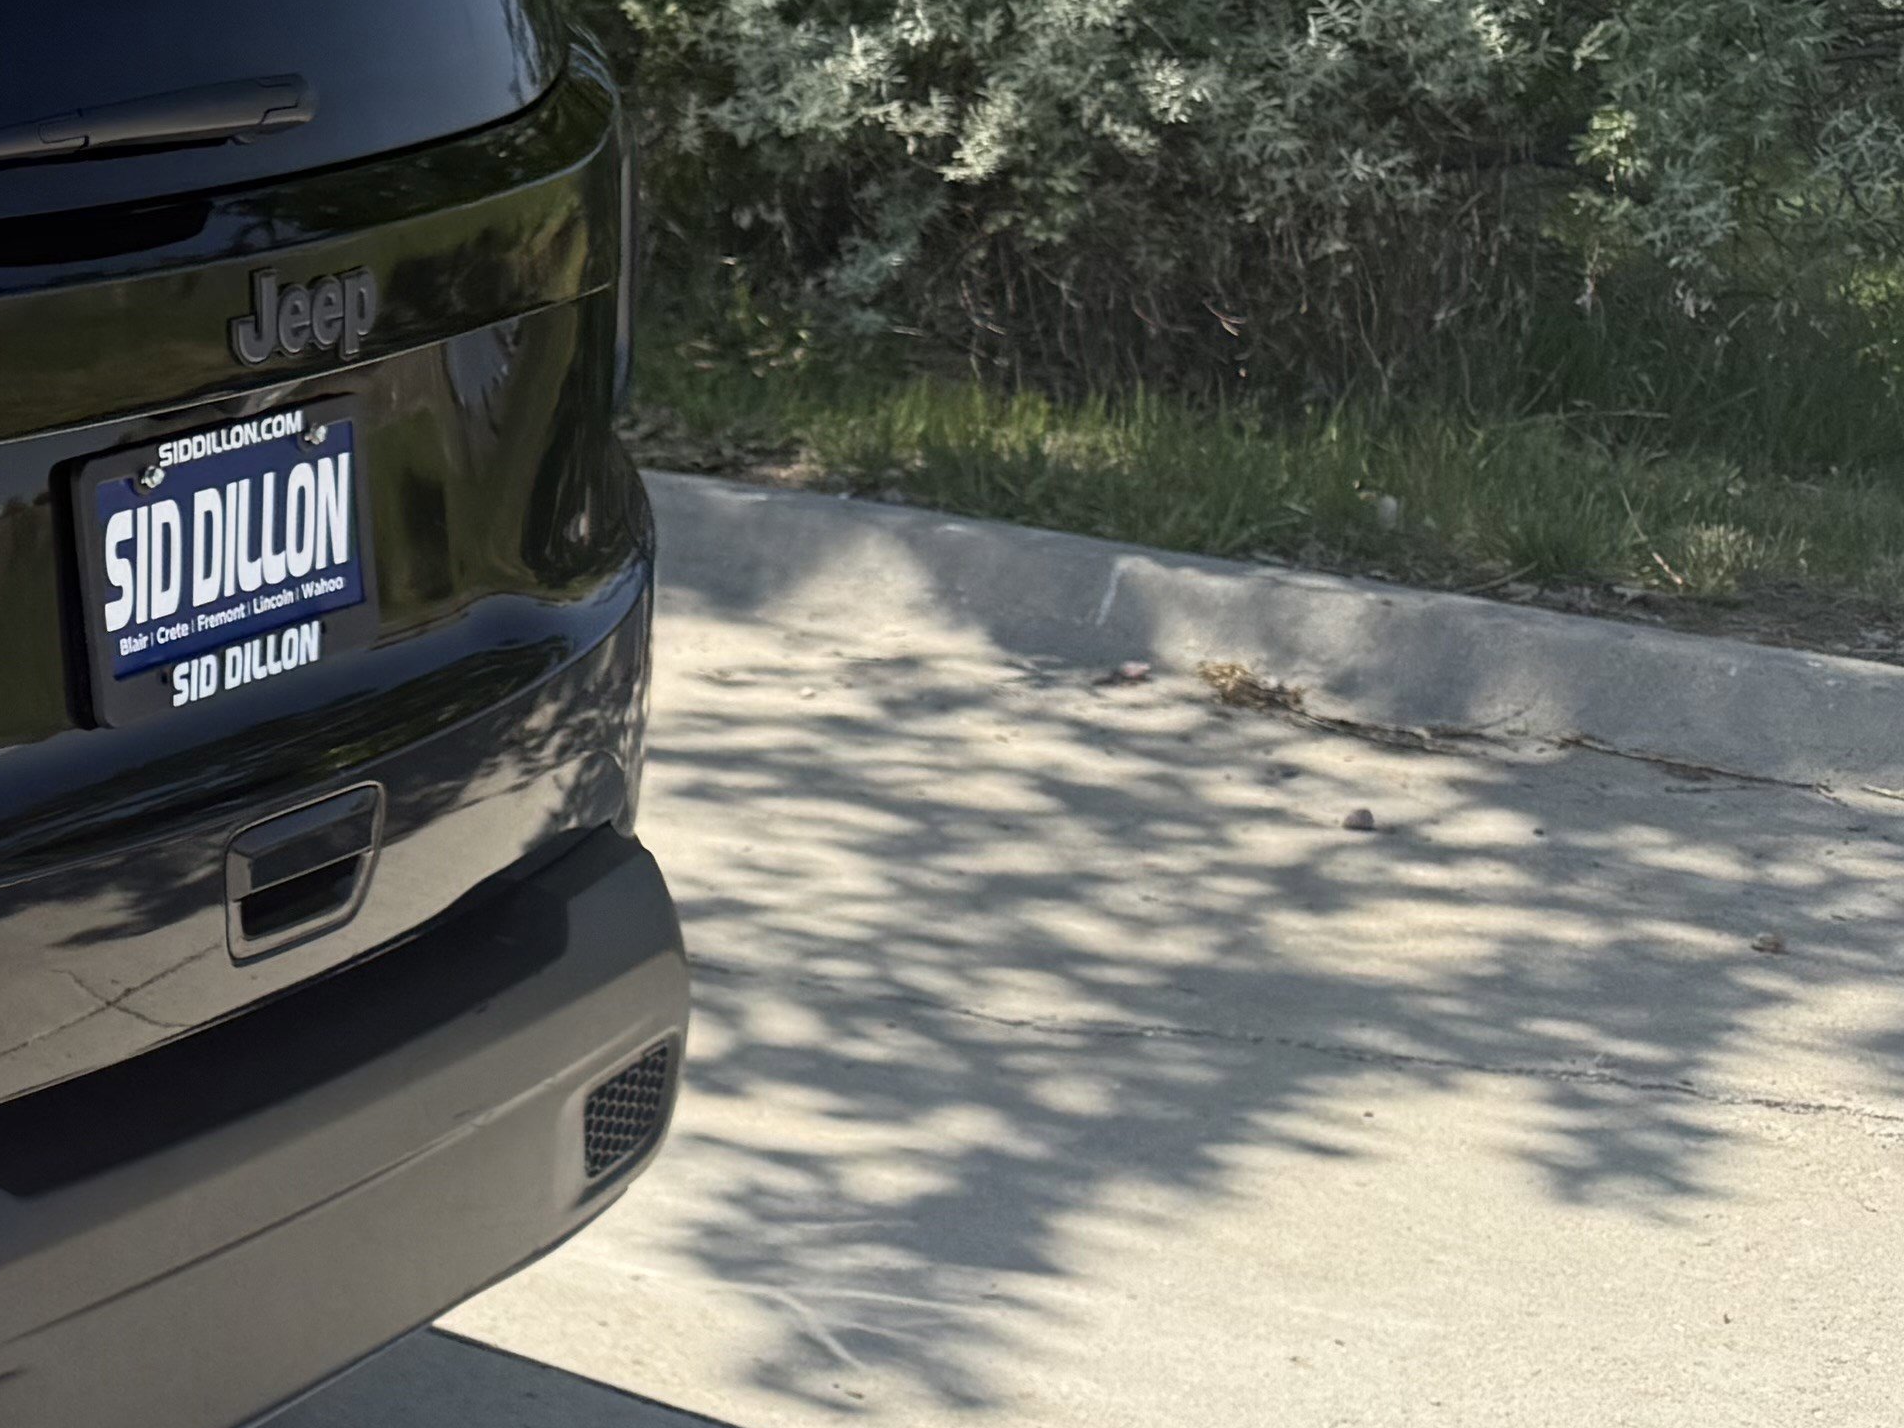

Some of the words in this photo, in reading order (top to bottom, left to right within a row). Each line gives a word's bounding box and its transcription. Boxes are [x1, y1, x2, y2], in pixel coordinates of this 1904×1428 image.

[229, 266, 377, 366] Jeep
[158, 410, 303, 468] SIDDILLON.COM
[105, 499, 182, 633] SID
[192, 452, 351, 608] DILLON
[119, 637, 149, 657] Blair
[157, 623, 190, 645] Crete
[197, 603, 246, 633] Fremont
[253, 589, 294, 615] Lincoln
[301, 576, 346, 600] Wahoo
[172, 654, 218, 707] SID
[224, 620, 320, 690] DILLON
